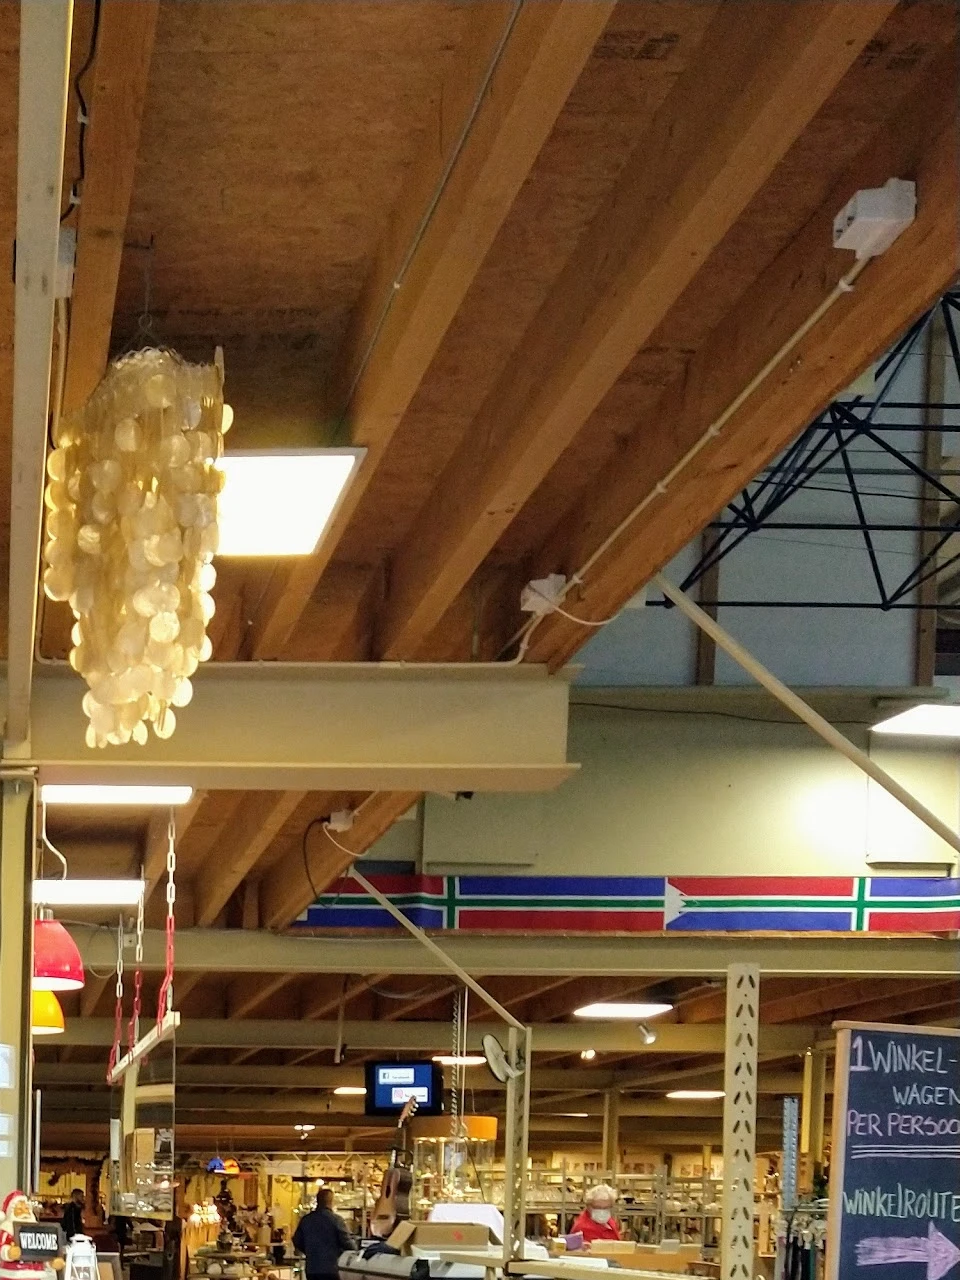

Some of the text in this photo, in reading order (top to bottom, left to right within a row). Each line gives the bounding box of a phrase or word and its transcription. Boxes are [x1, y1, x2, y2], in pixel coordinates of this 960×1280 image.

[850, 1036, 871, 1072] 1
[892, 1082, 960, 1106] WAGEN
[847, 1109, 883, 1137] PER
[842, 1182, 960, 1222] WINKELROUTE
[19, 1232, 58, 1250] WELCOME
